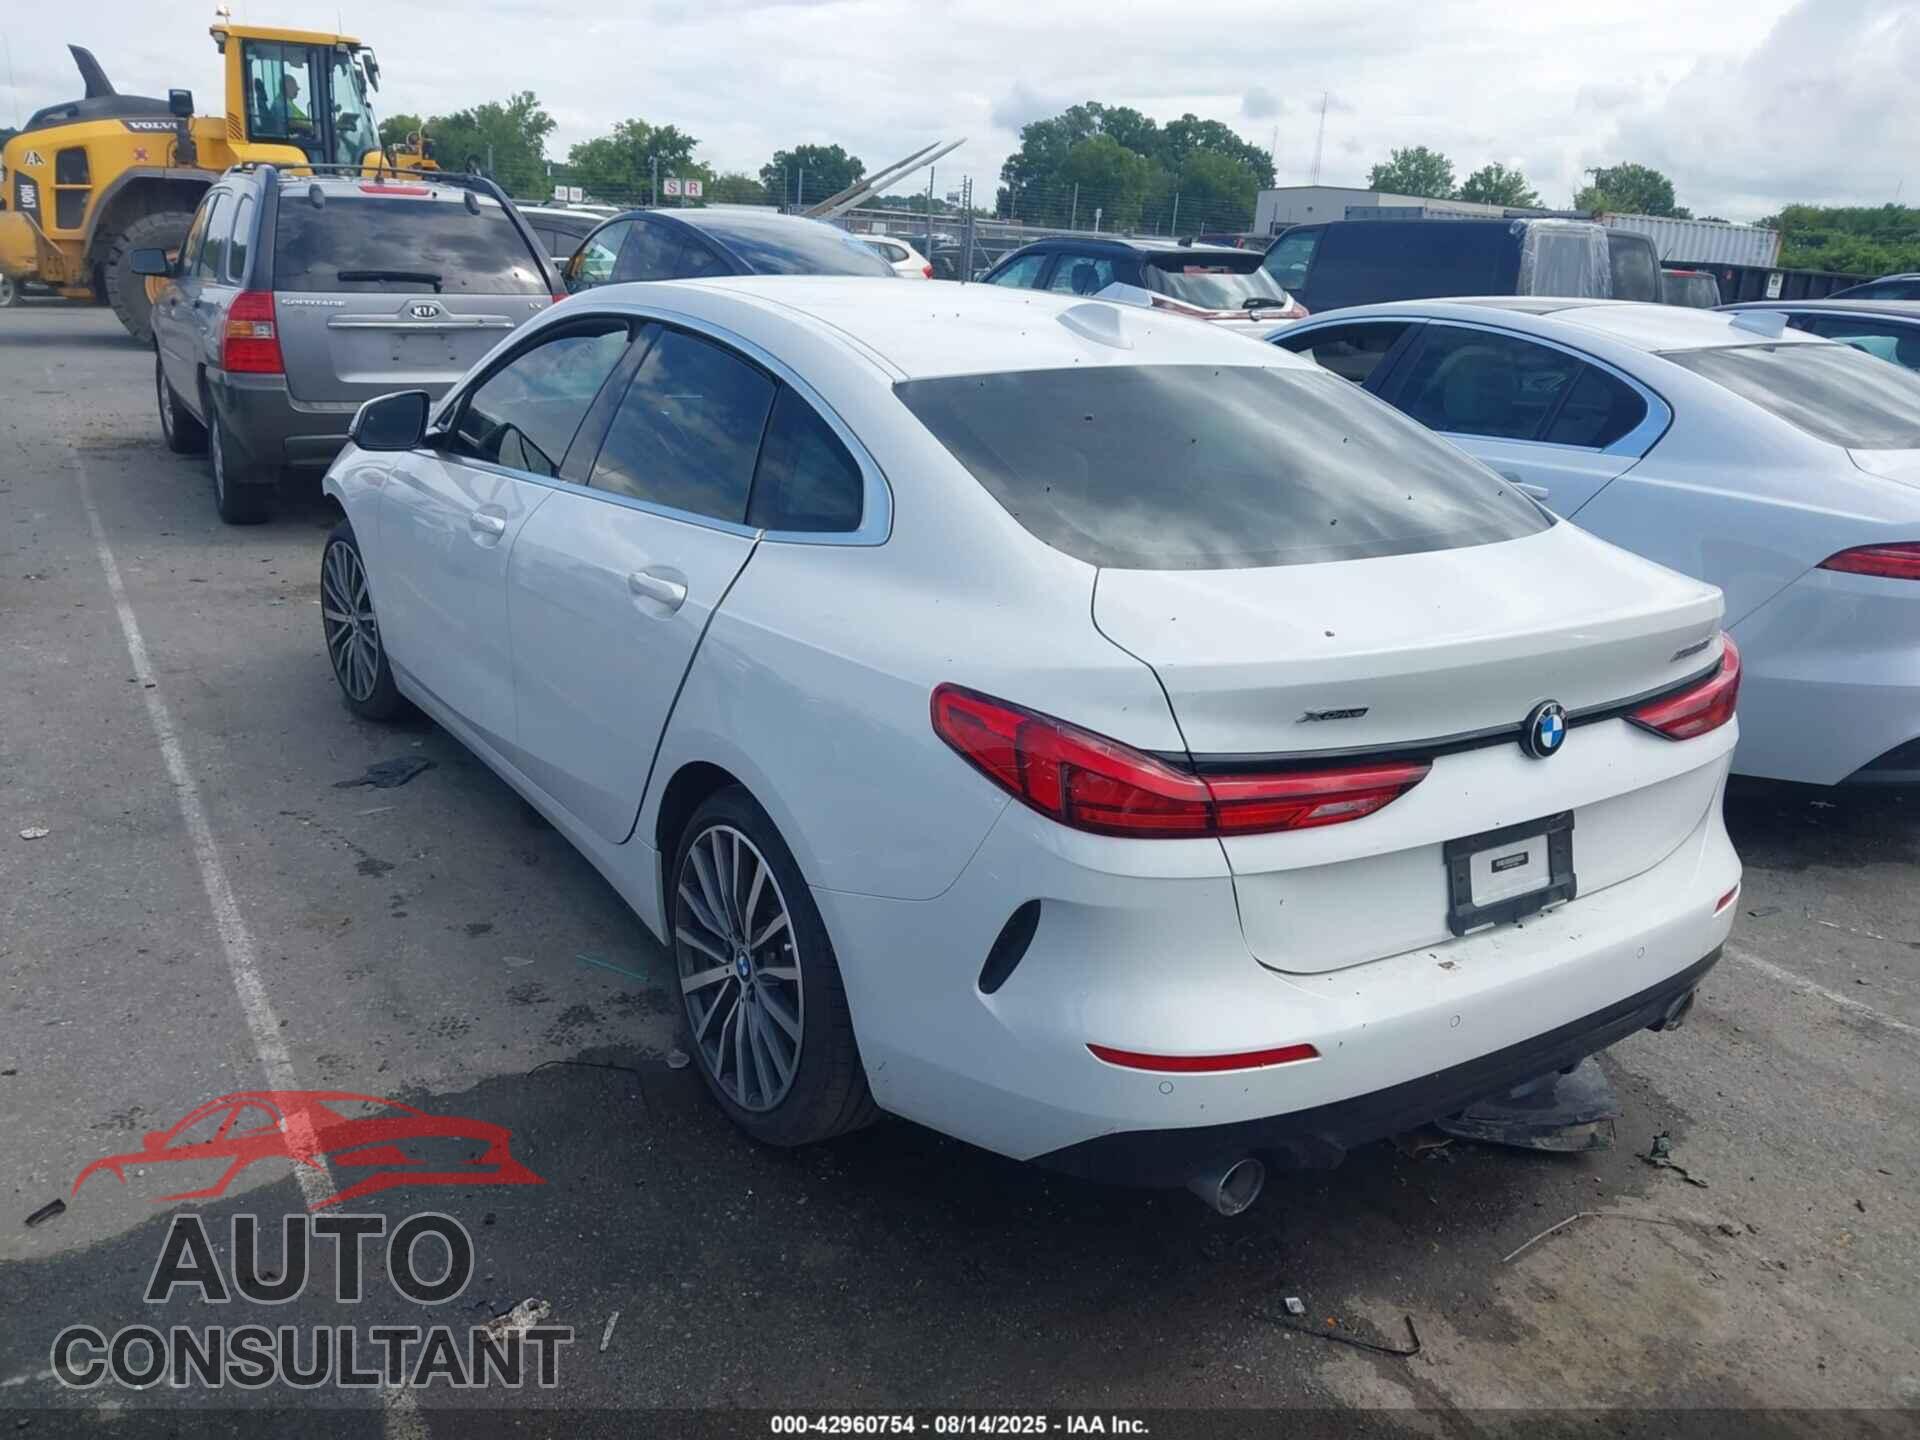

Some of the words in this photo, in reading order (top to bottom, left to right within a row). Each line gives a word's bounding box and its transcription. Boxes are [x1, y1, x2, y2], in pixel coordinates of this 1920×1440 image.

[667, 181, 677, 193] S
[688, 182, 699, 194] R
[414, 306, 436, 316] KIA
